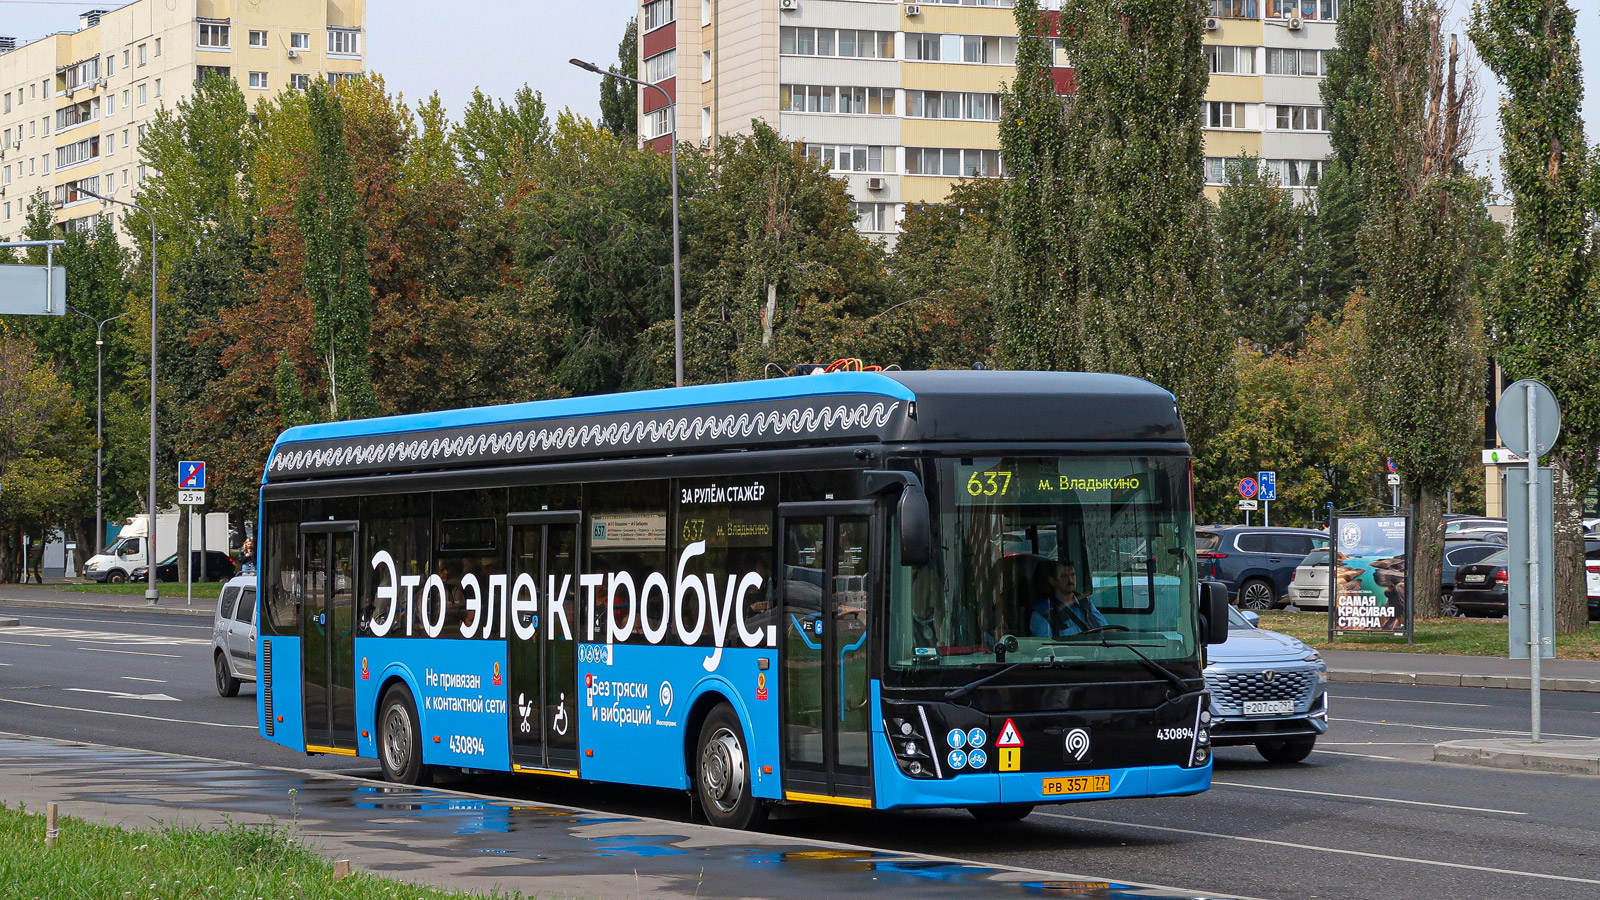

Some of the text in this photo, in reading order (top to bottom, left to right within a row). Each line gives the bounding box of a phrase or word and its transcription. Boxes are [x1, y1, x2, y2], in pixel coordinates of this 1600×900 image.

[681, 482, 765, 504] ЗА РУЛЁМ СТАЖЁР
[967, 471, 1140, 496] 637 м. Владыкино
[182, 493, 194, 502] 25
[594, 525, 606, 537] 637
[682, 519, 705, 541] 637
[727, 522, 769, 537] Владыкино
[369, 550, 446, 637] Это
[1338, 595, 1376, 607] САМАЯ
[1338, 606, 1395, 617] КРАСИВАЯ
[1338, 616, 1381, 628] СТРАНА
[425, 667, 481, 692] Не привязан
[592, 675, 648, 702] Без тряски
[425, 694, 506, 714] к контактной сети
[592, 701, 652, 728] и вибраций
[1157, 727, 1194, 741] 430894
[449, 734, 485, 756] 430894
[1067, 778, 1089, 792] 357
[1095, 776, 1106, 787] 77
